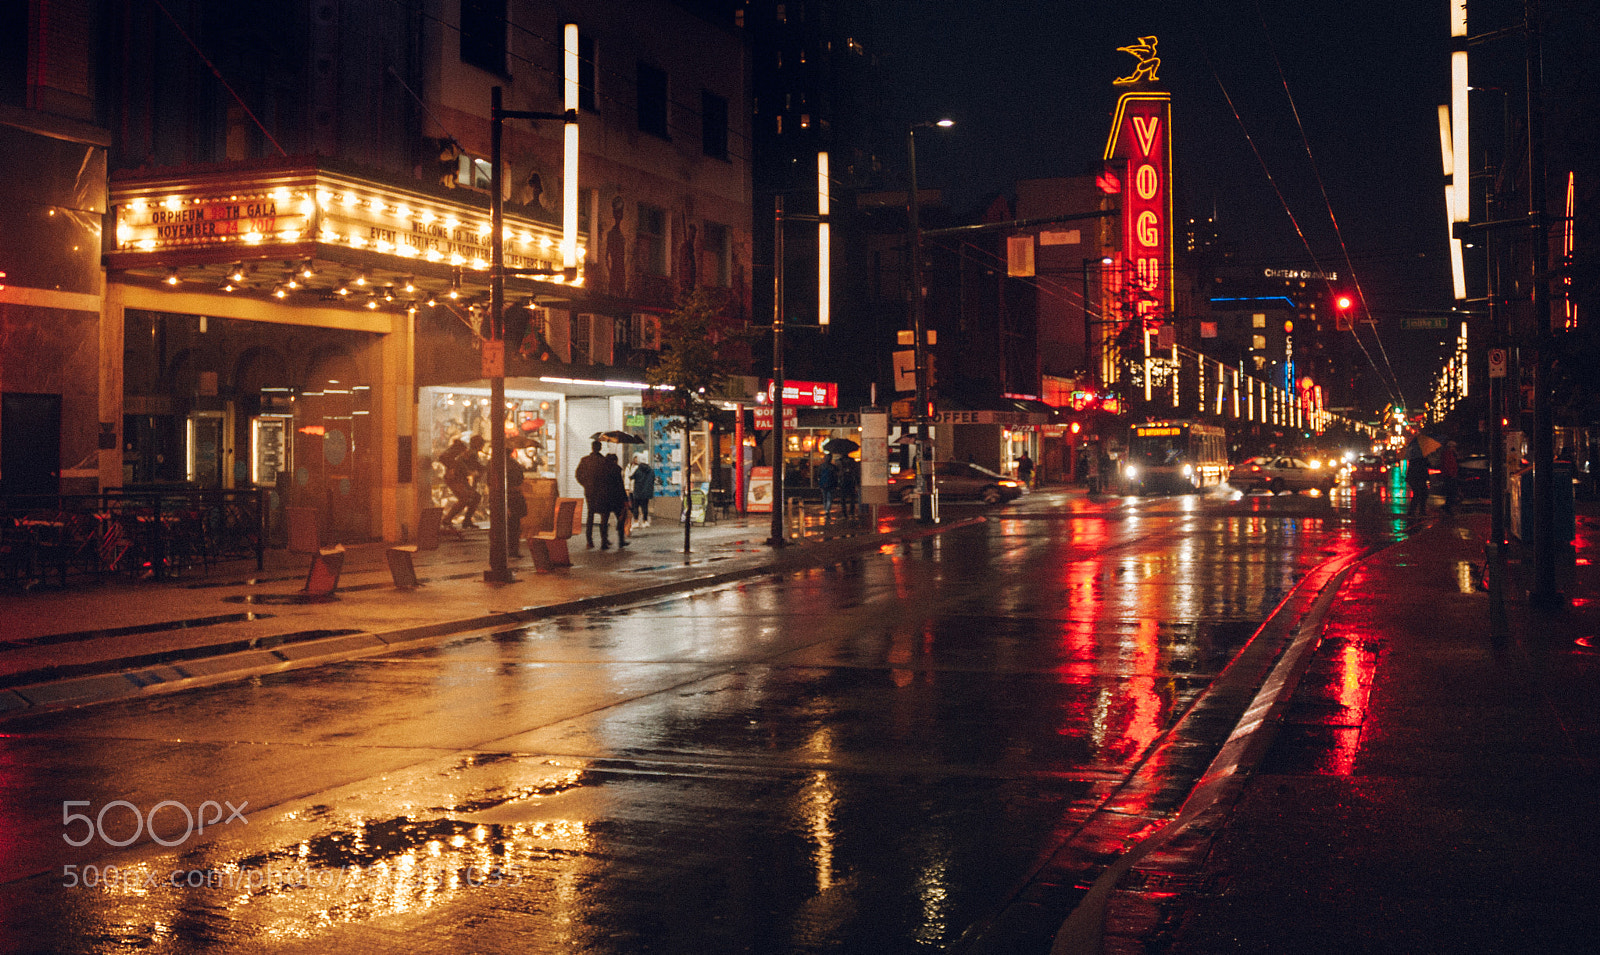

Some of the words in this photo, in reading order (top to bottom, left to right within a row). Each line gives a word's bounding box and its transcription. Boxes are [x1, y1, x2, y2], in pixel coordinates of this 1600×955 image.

[152, 208, 204, 224] ORPHEUM
[247, 202, 277, 217] GALA
[157, 222, 216, 239] NOVEMBER
[225, 221, 239, 234] 24
[250, 218, 276, 232] 2017
[412, 221, 448, 239] WELCOME
[453, 229, 463, 242] TO
[465, 231, 479, 245] THE
[1132, 116, 1159, 335] VOGUE
[370, 226, 396, 243] EVENT
[404, 234, 439, 253] LISTINGS
[756, 408, 793, 416] DONIR
[934, 411, 980, 424] OFFEE
[756, 420, 796, 428] FALEL
